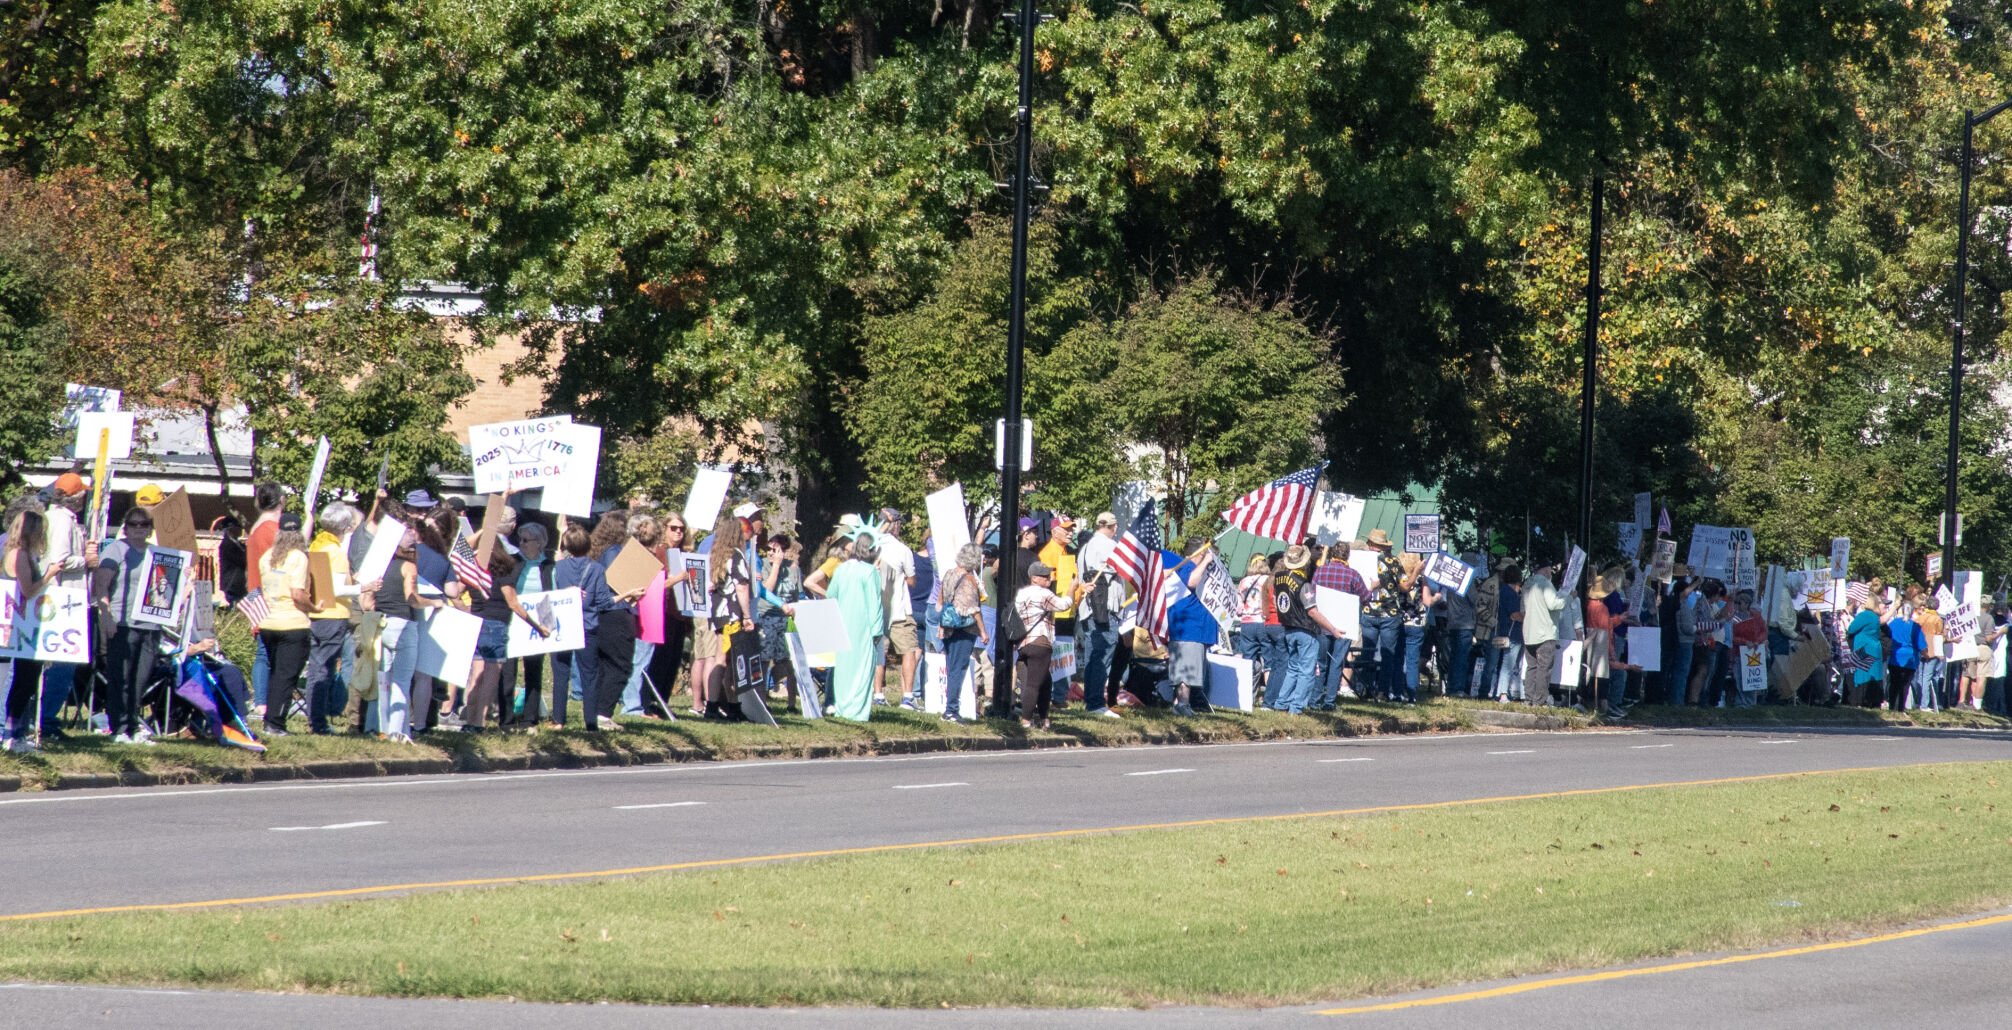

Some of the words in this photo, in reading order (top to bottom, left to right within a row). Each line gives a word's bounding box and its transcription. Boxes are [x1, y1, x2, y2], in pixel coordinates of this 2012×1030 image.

[475, 447, 501, 466] 2025
[547, 440, 573, 454] 1776
[1730, 530, 1747, 541] NO
[1409, 540, 1437, 548] KING
[1203, 593, 1220, 613] WAY
[1207, 573, 1220, 594] THE
[1219, 591, 1236, 618] LONG
[5, 590, 57, 622] NO
[142, 606, 153, 614] NOT
[1749, 667, 1761, 677] NO
